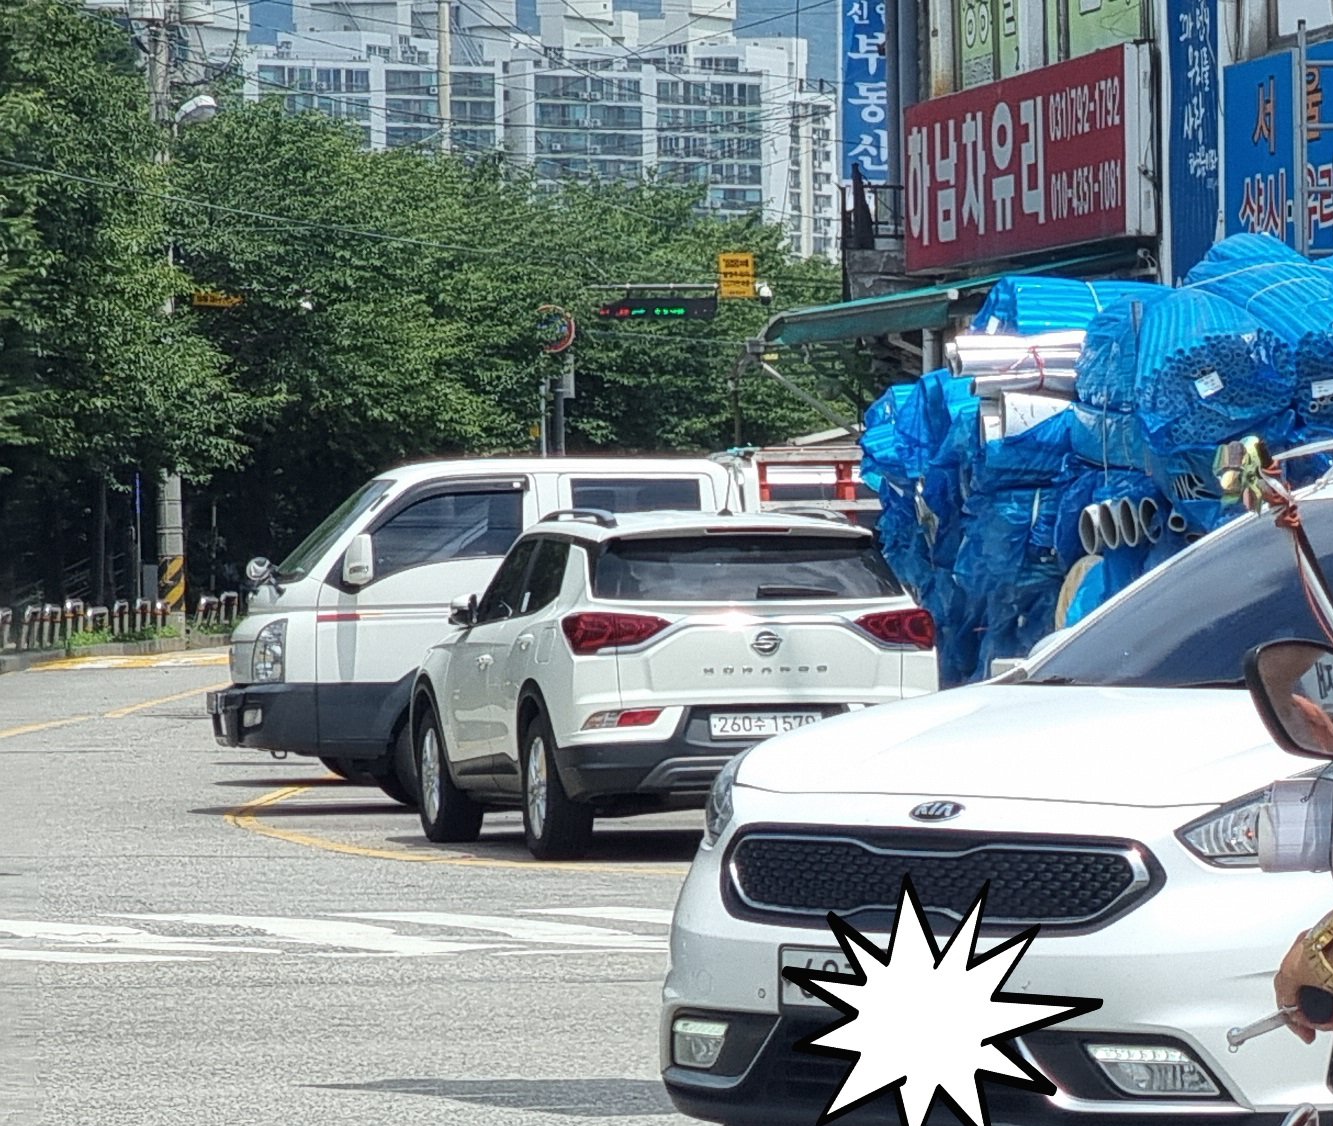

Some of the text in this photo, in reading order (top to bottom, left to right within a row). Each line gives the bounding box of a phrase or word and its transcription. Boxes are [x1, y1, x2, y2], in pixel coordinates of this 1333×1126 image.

[1048, 76, 1121, 142] 031)792-1792
[907, 100, 1046, 246] 하남차유리
[1049, 158, 1123, 222] 010-4351-1081
[914, 801, 956, 817] KIA
